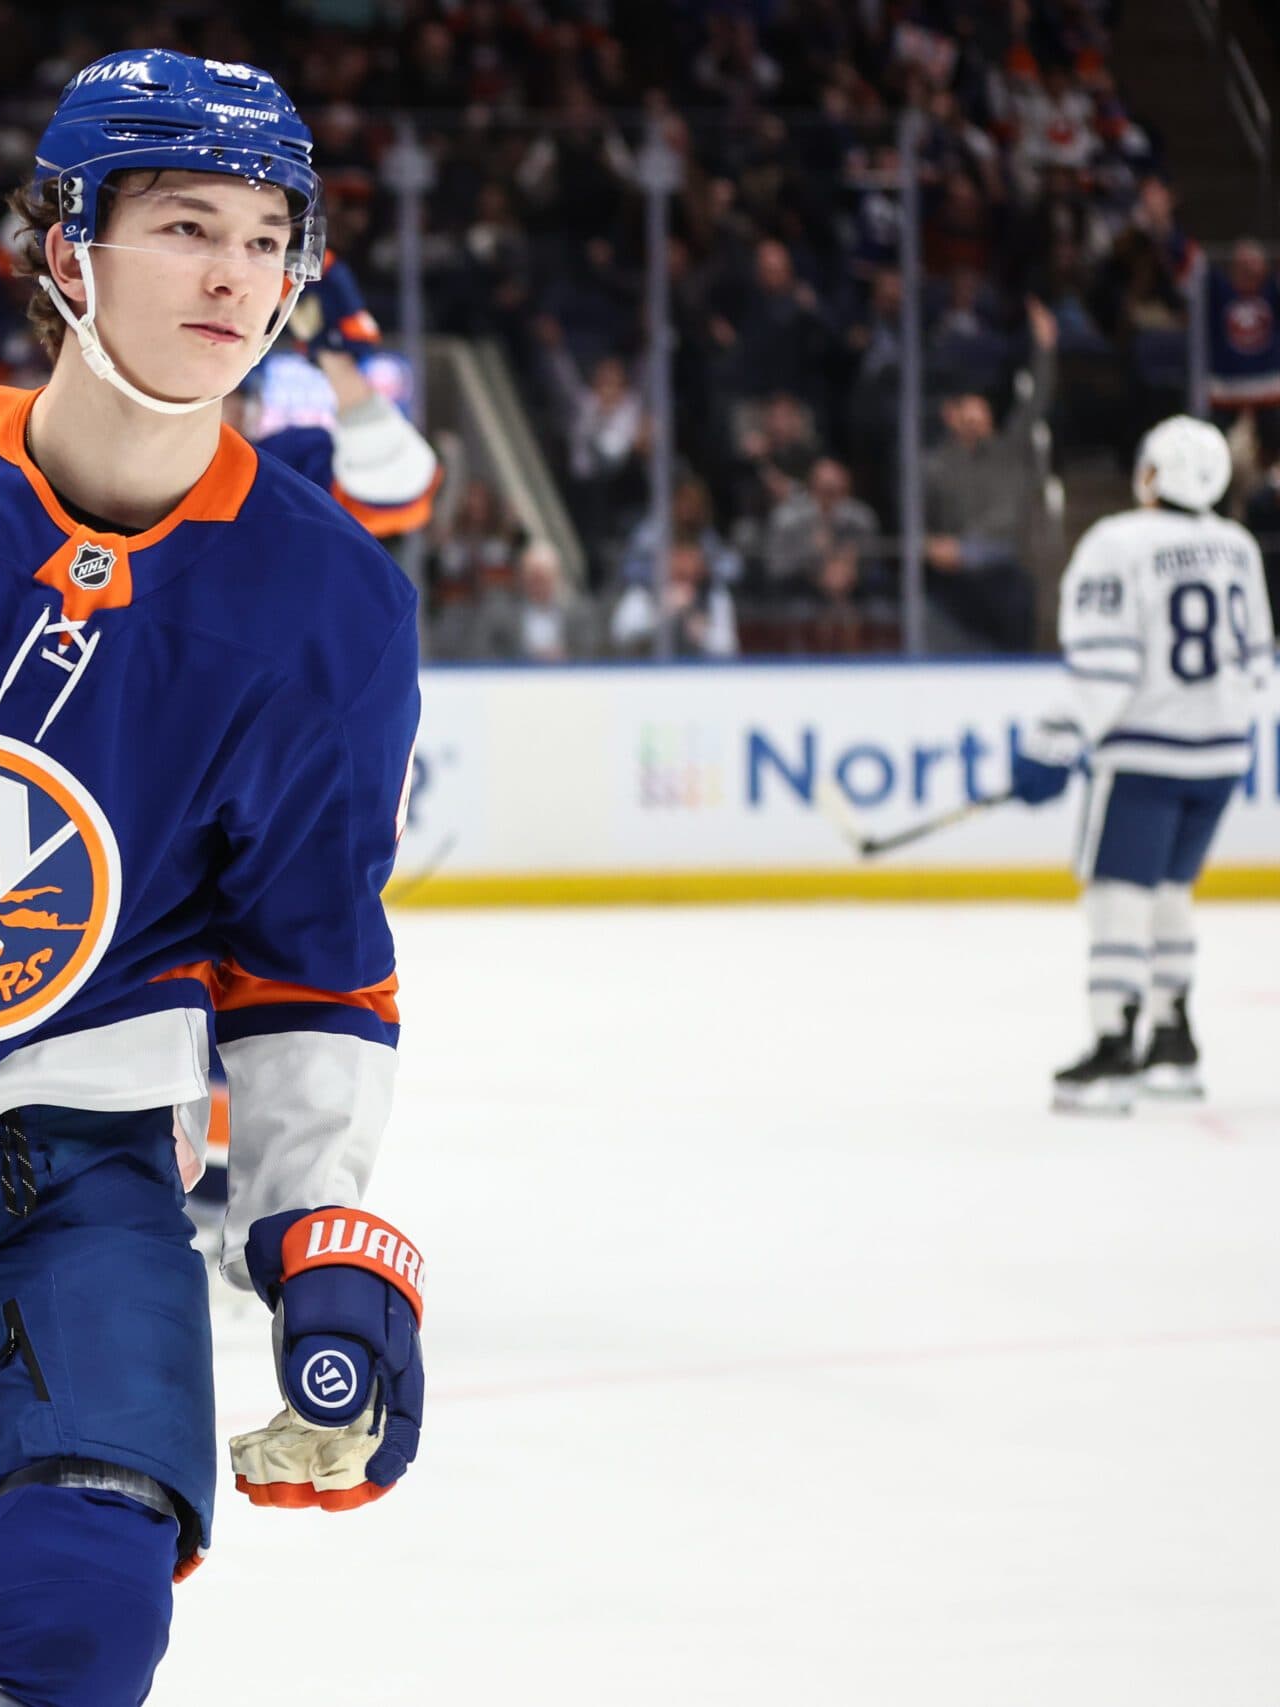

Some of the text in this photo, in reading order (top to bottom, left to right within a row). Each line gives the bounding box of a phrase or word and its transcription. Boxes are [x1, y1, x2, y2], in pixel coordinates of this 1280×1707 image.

[205, 102, 280, 124] WARRIOR
[77, 560, 106, 577] NHL
[305, 1218, 425, 1295] WAR
